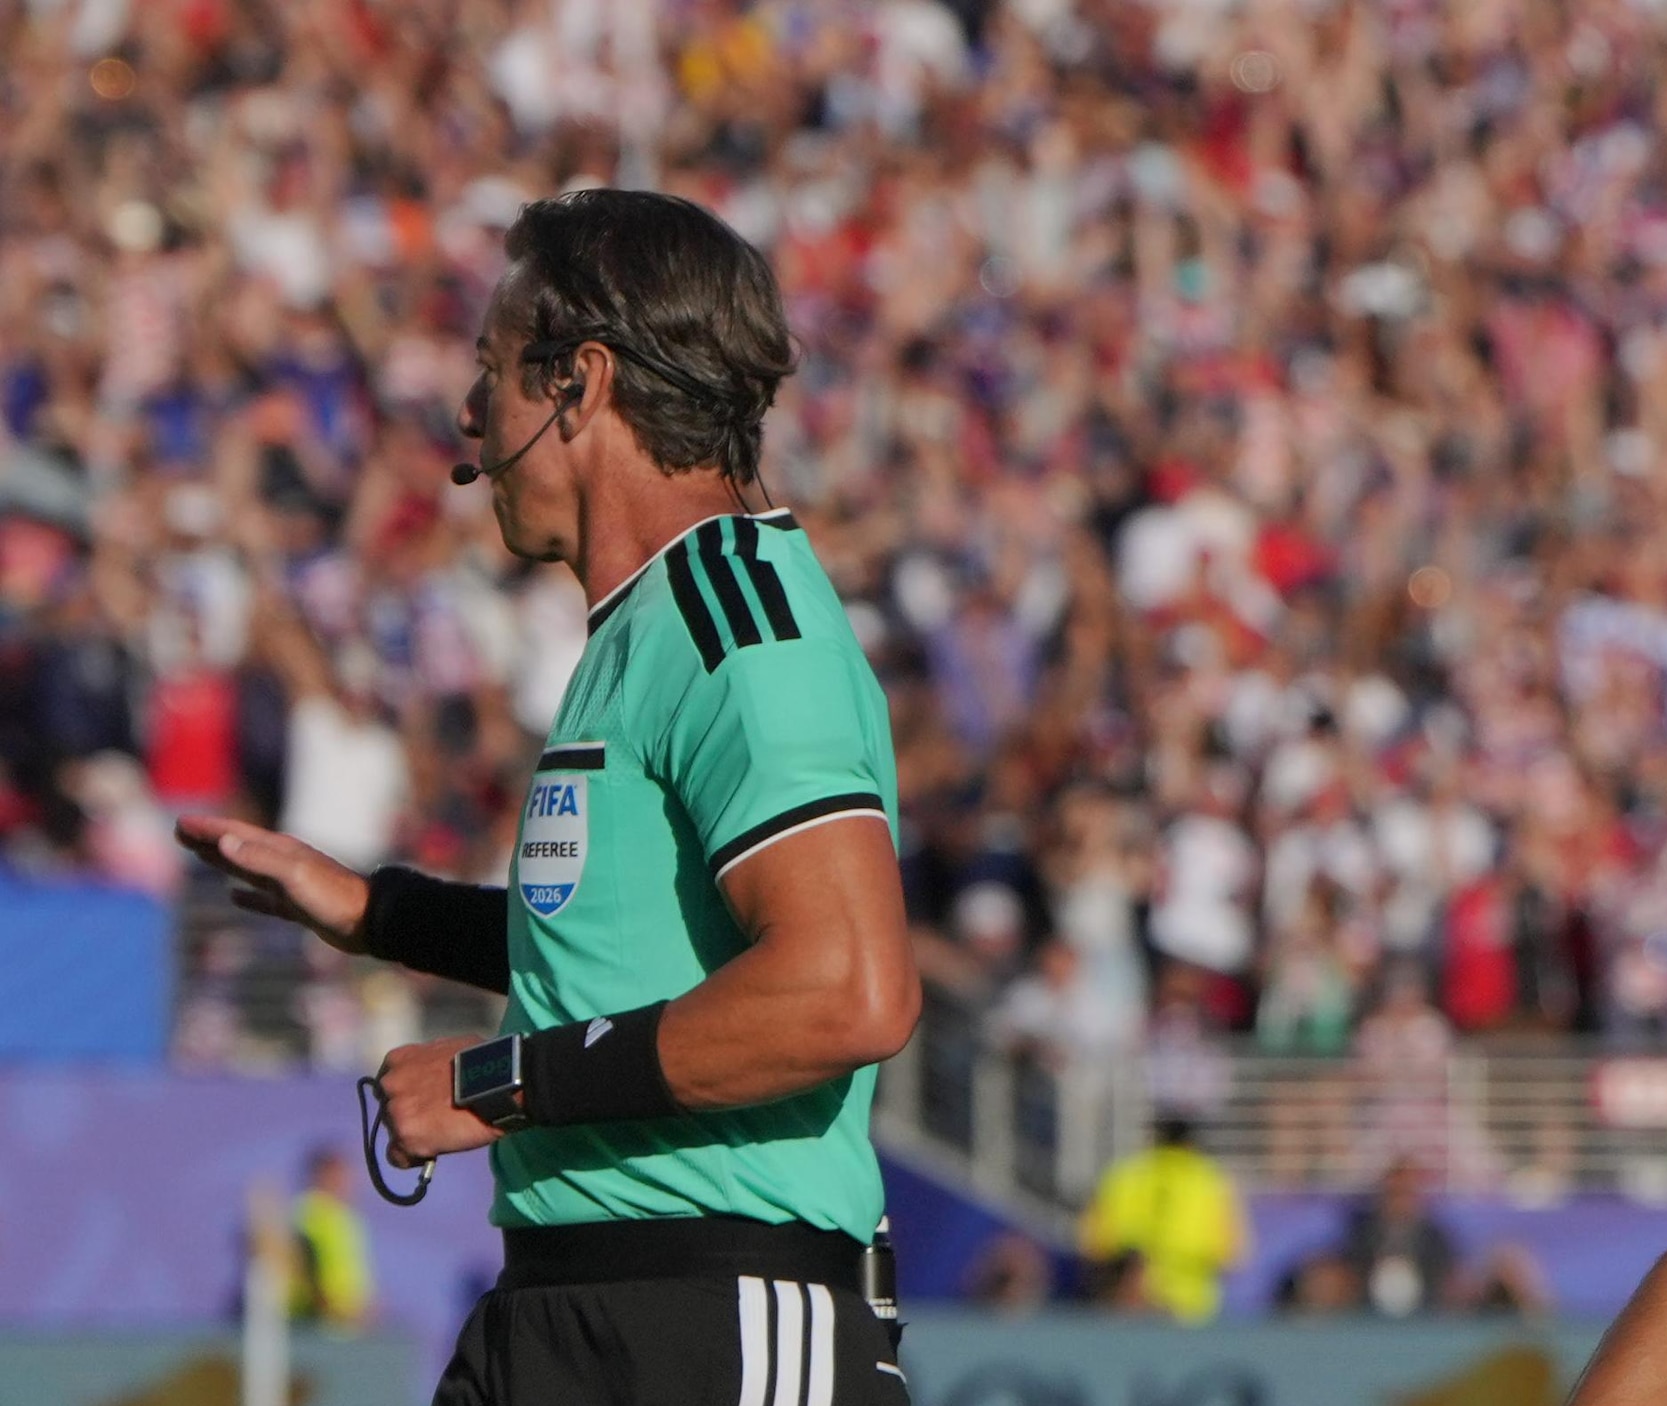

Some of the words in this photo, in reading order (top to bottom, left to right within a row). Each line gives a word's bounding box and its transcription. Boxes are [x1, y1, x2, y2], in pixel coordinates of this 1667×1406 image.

[529, 785, 578, 816] FIFA
[522, 842, 578, 858] REFEREE
[531, 888, 561, 903] 2026
